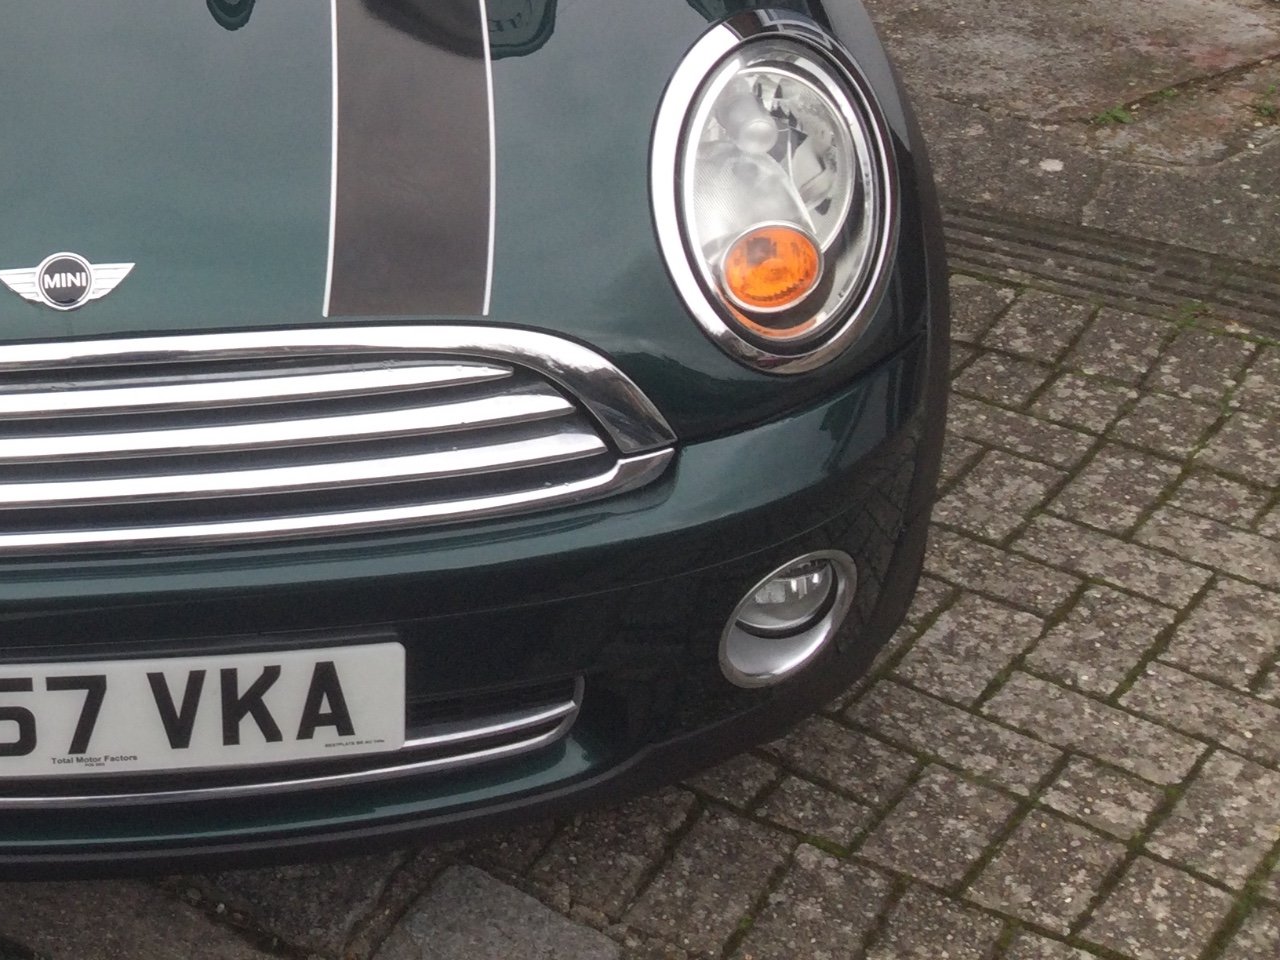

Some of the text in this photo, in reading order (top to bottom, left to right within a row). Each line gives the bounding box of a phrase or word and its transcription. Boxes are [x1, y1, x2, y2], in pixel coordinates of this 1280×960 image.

[43, 271, 87, 289] MINI
[146, 661, 356, 750] VKA
[51, 754, 138, 765] Total Motor Factors
